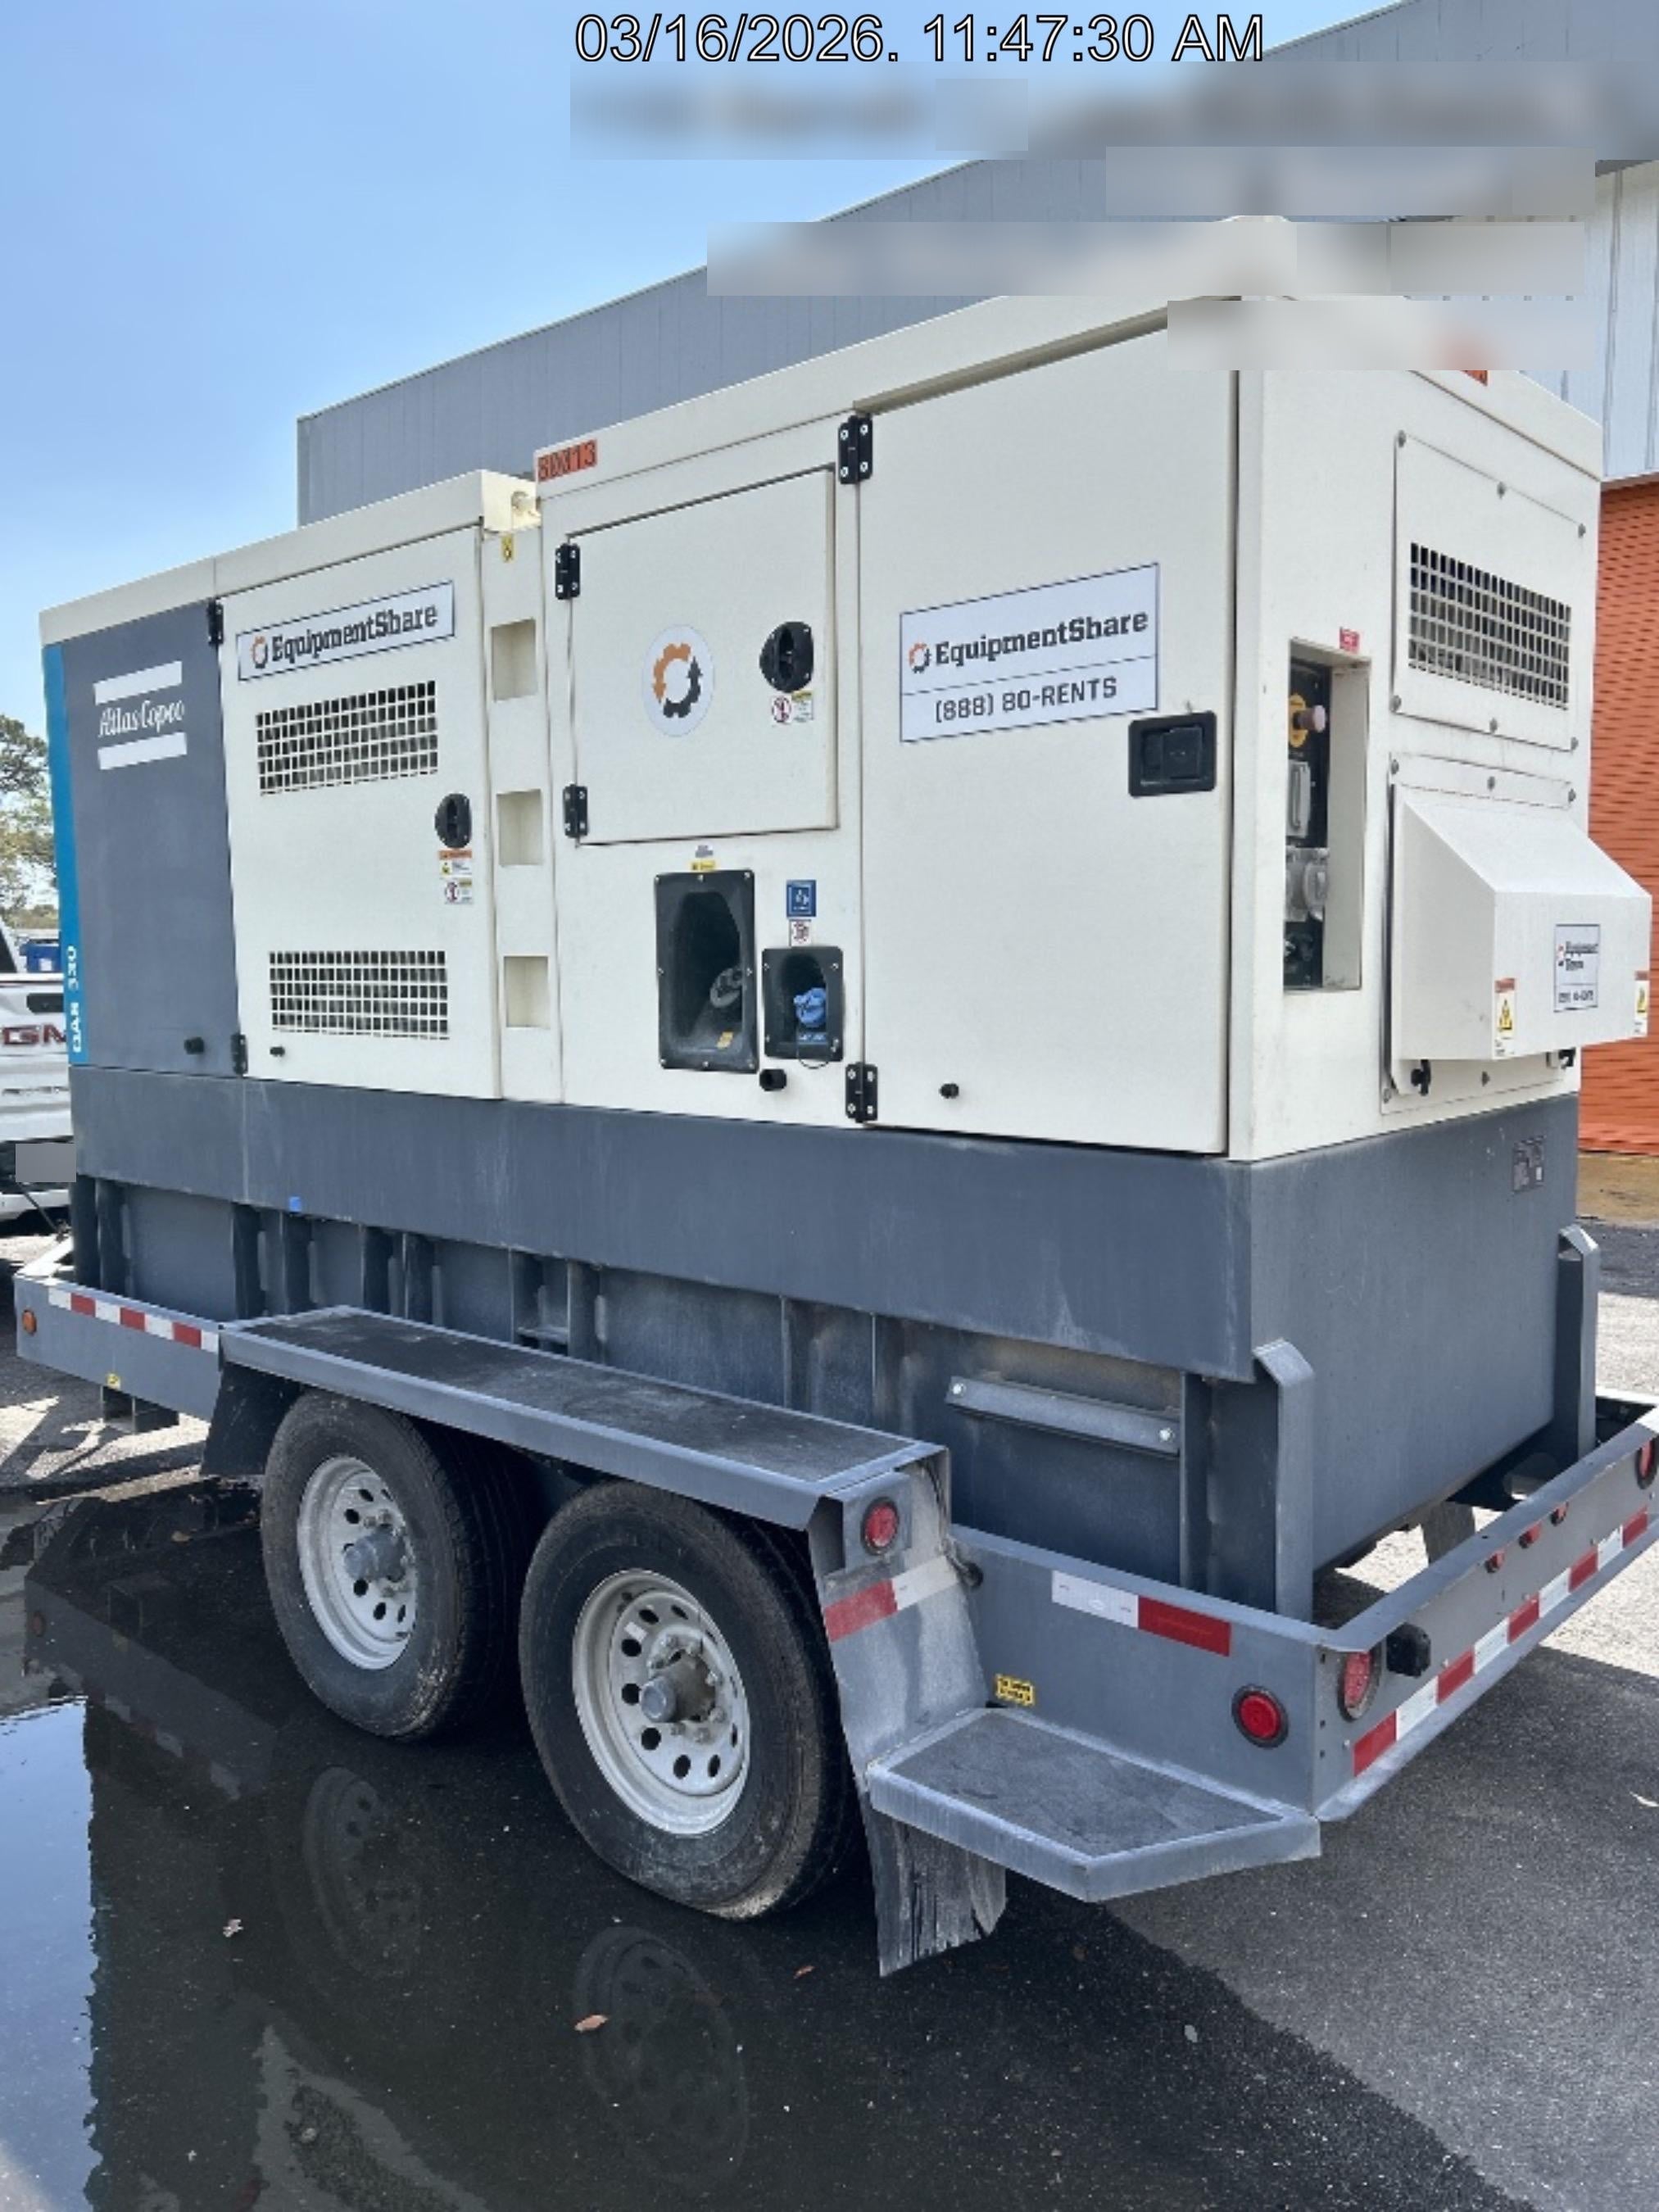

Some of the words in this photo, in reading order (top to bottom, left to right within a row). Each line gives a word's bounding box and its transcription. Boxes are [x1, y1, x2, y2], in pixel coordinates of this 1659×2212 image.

[271, 605, 438, 664] EquipmentShare
[935, 612, 1148, 667] EquipmentShare
[98, 707, 138, 737] Atlas
[935, 693, 994, 723] (888)
[1002, 676, 1117, 712] 80-RENTS
